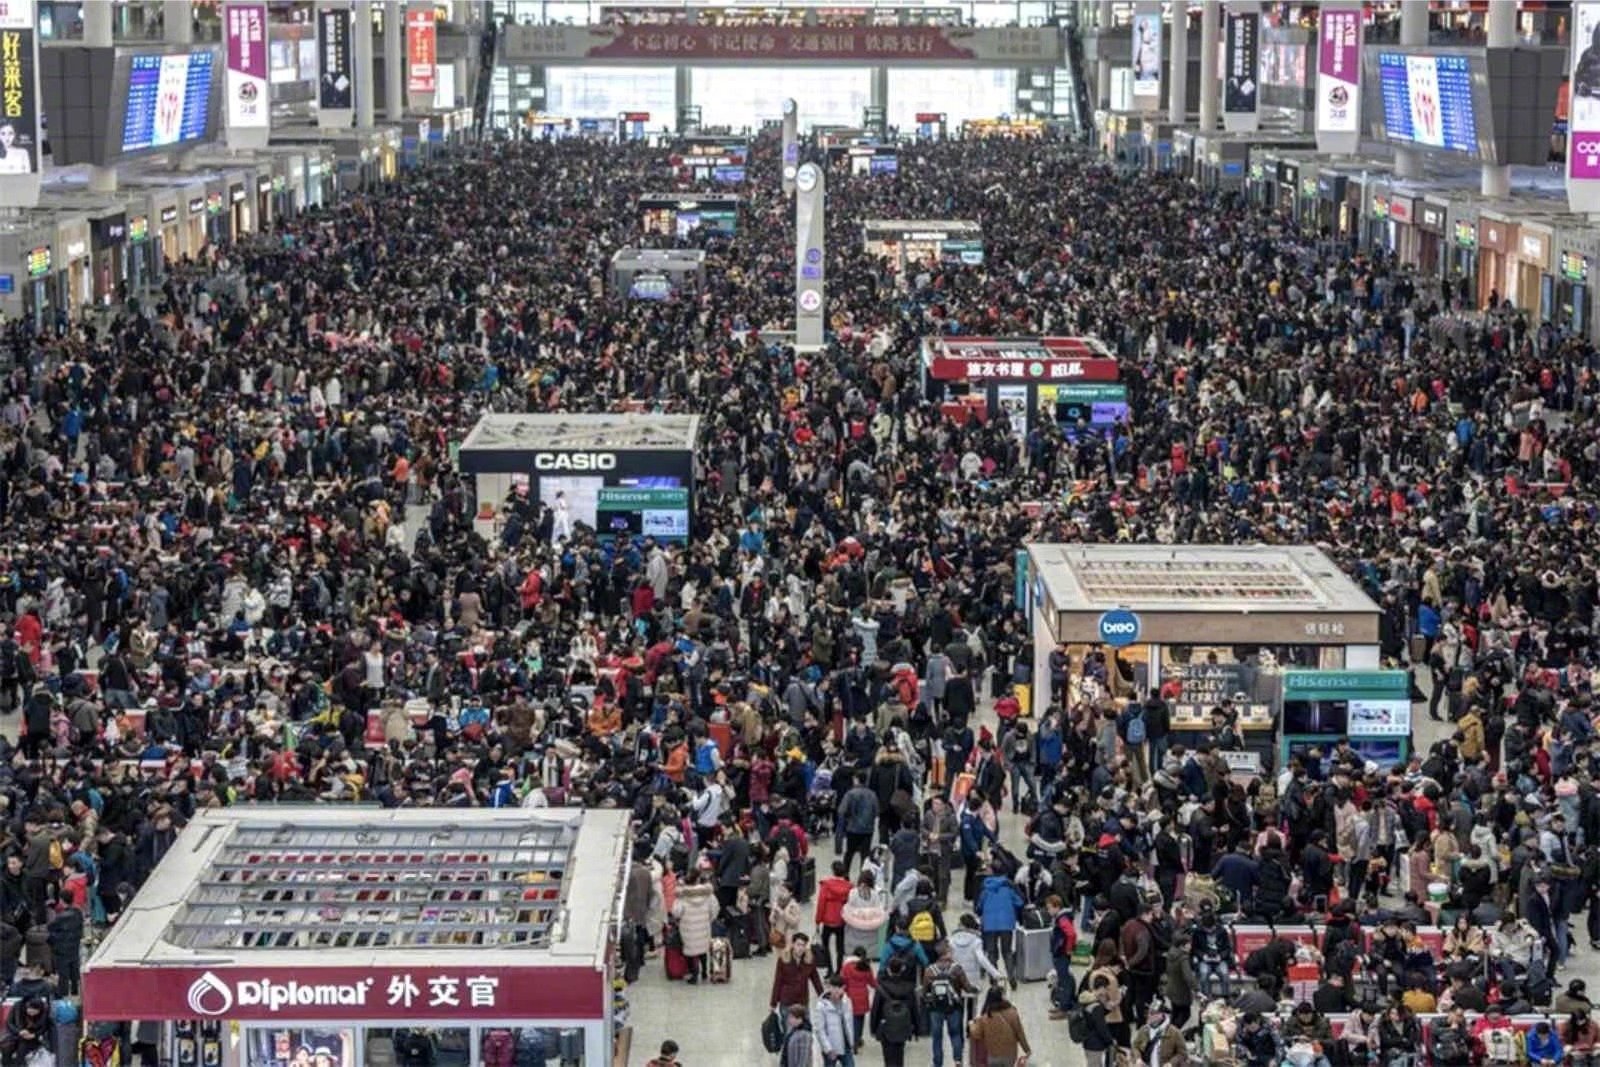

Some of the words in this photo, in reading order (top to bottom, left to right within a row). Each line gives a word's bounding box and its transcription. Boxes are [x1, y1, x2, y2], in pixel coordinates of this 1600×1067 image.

[631, 34, 697, 50] 不忘初心
[709, 34, 775, 50] 牢记使命
[790, 34, 855, 51] 交通强国
[865, 34, 934, 51] 铁路先行
[3, 30, 23, 117] 好莱客
[535, 453, 616, 470] CASIO
[600, 492, 651, 502] Hisense
[1103, 622, 1135, 634] breo
[1289, 675, 1359, 687] Hisense
[236, 978, 369, 1011] Diplomat
[387, 974, 499, 1008] 外交官
